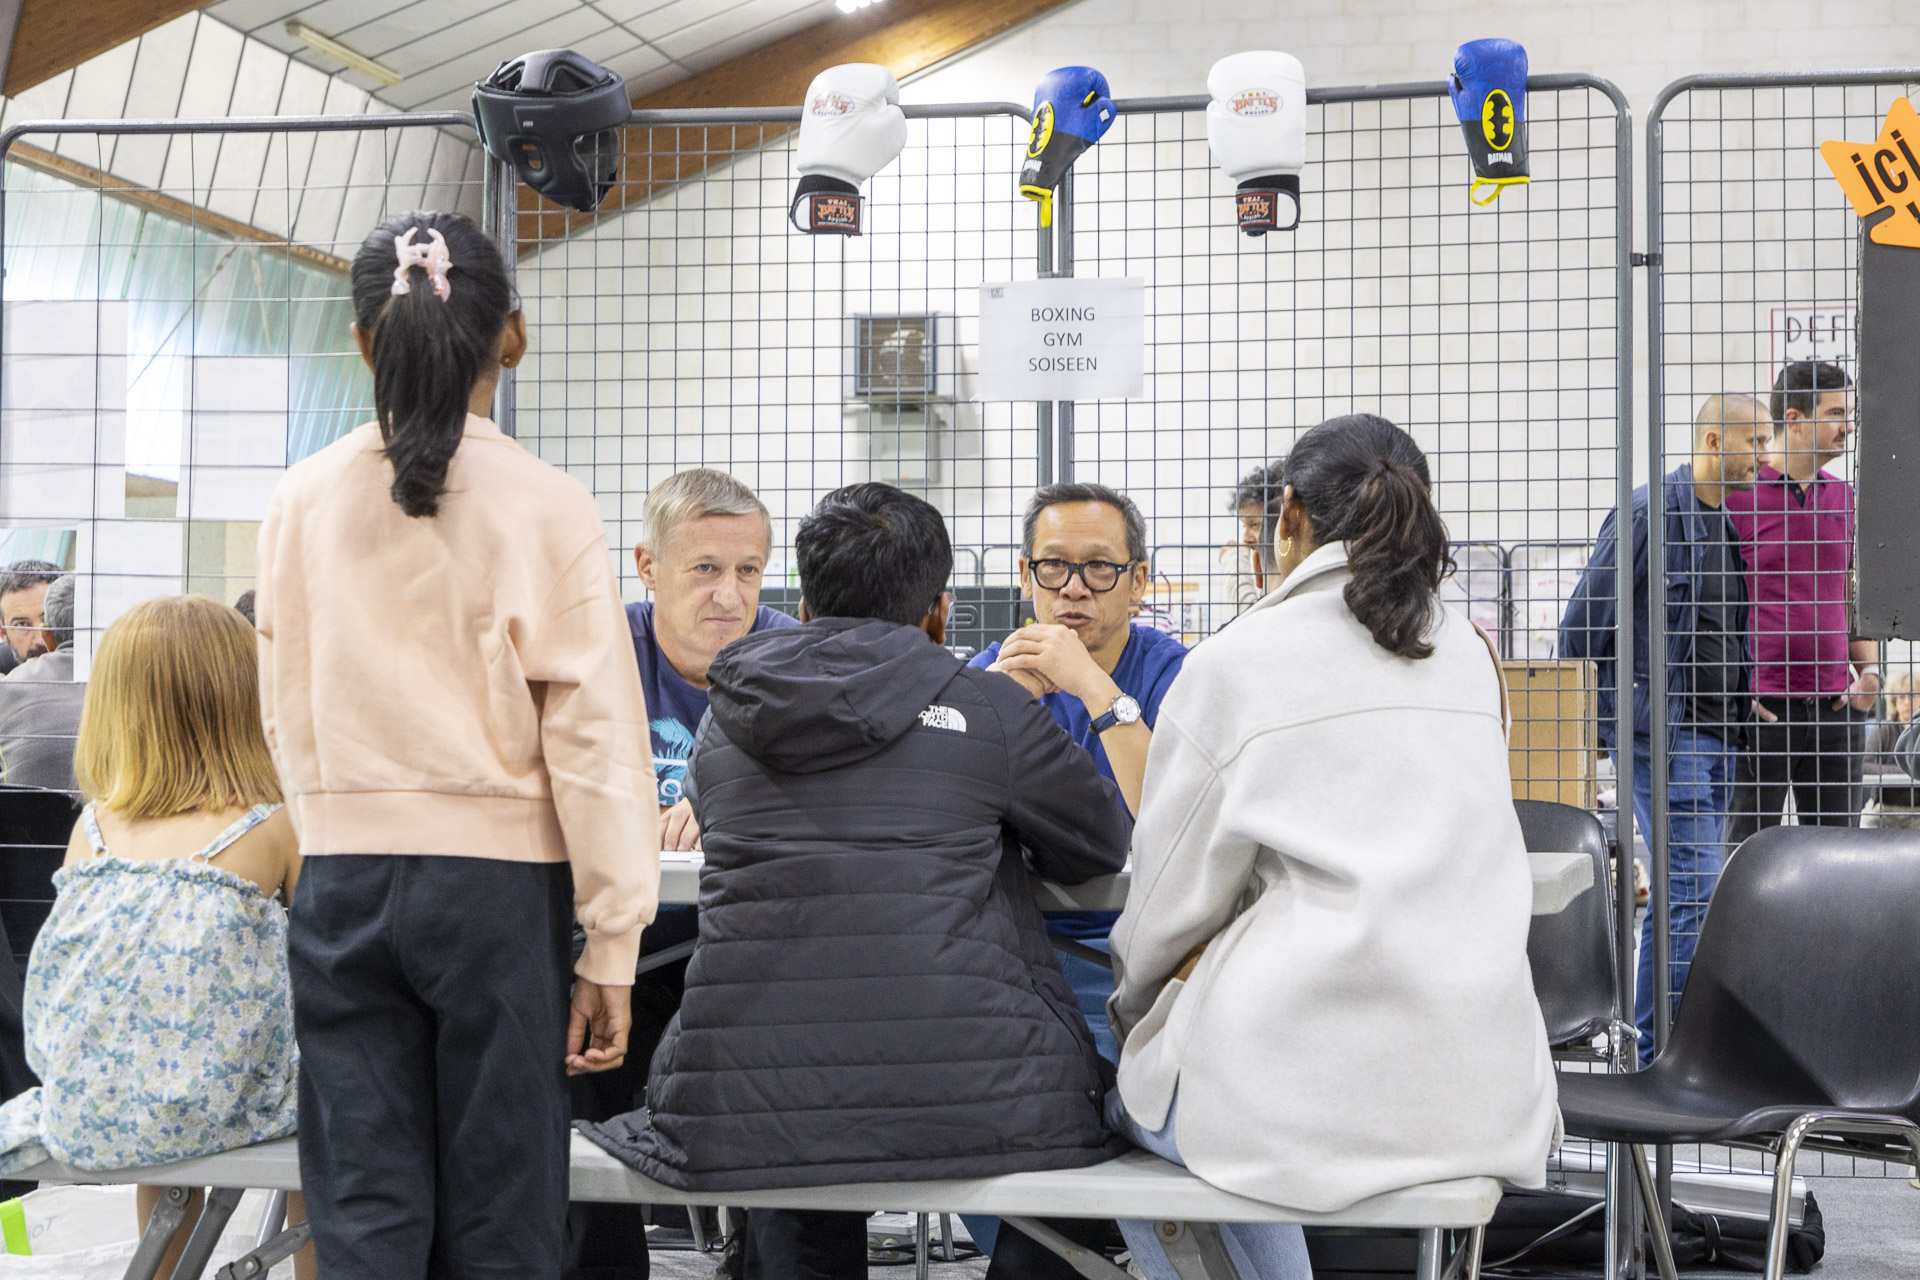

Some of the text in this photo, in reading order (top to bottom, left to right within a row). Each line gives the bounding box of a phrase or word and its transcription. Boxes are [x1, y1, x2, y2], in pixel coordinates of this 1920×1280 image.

[1487, 152, 1513, 166] BATMAN
[817, 203, 855, 223] BATTLE
[1031, 307, 1095, 322] BOXING
[1043, 332, 1082, 347] GYM
[1028, 357, 1097, 372] SOISEEN
[918, 710, 948, 721] ORTH
[928, 704, 948, 714] THE
[923, 718, 948, 729] FACE
